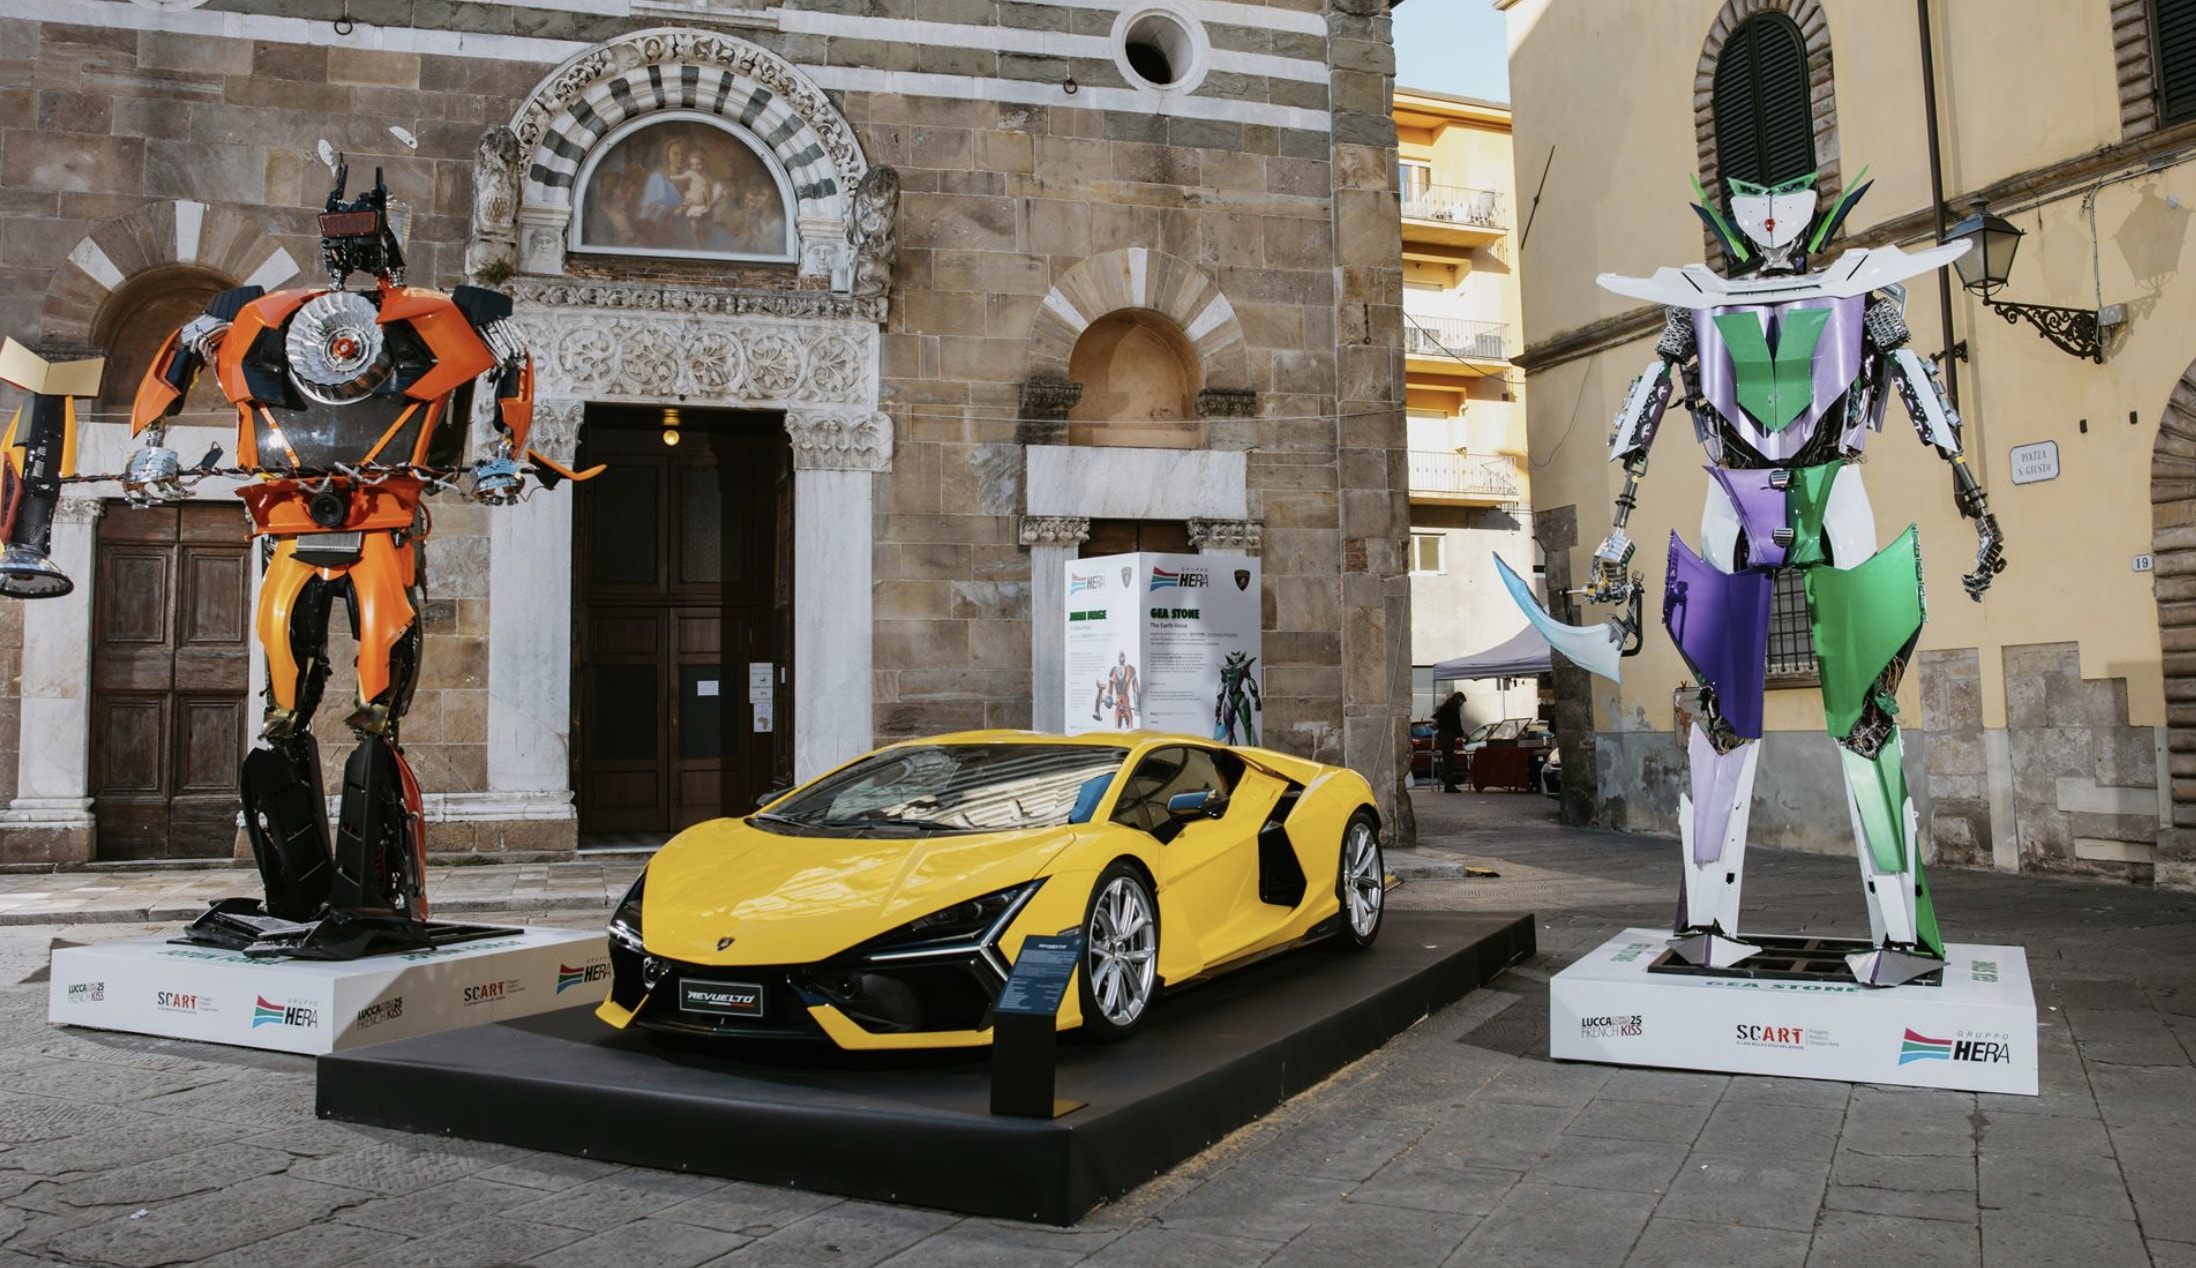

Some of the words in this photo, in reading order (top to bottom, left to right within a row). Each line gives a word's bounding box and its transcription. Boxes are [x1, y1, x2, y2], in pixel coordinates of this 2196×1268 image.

[2021, 450, 2047, 462] PIAZZA
[2025, 463, 2052, 475] GIUSTO
[2136, 557, 2149, 569] 19
[1178, 573, 1209, 588] HERA
[1150, 608, 1169, 619] GEA
[1171, 608, 1200, 620] STONE
[584, 963, 612, 983] HERA
[1705, 980, 1760, 988] GEA
[464, 981, 505, 1002] SCART
[687, 990, 756, 1003] REVUELTO
[157, 991, 198, 1010] SCART
[284, 1007, 318, 1028] HERA
[358, 1004, 381, 1020] LUCCA
[1581, 1016, 1612, 1027] LUCCA
[1630, 1015, 1642, 1025] 25
[1581, 1026, 1619, 1038] FRENCH
[1620, 1024, 1642, 1036] KISS
[1736, 1024, 1804, 1044] SCART
[1957, 1030, 2009, 1040] GRUPPO
[1953, 1040, 2010, 1064] HERA
